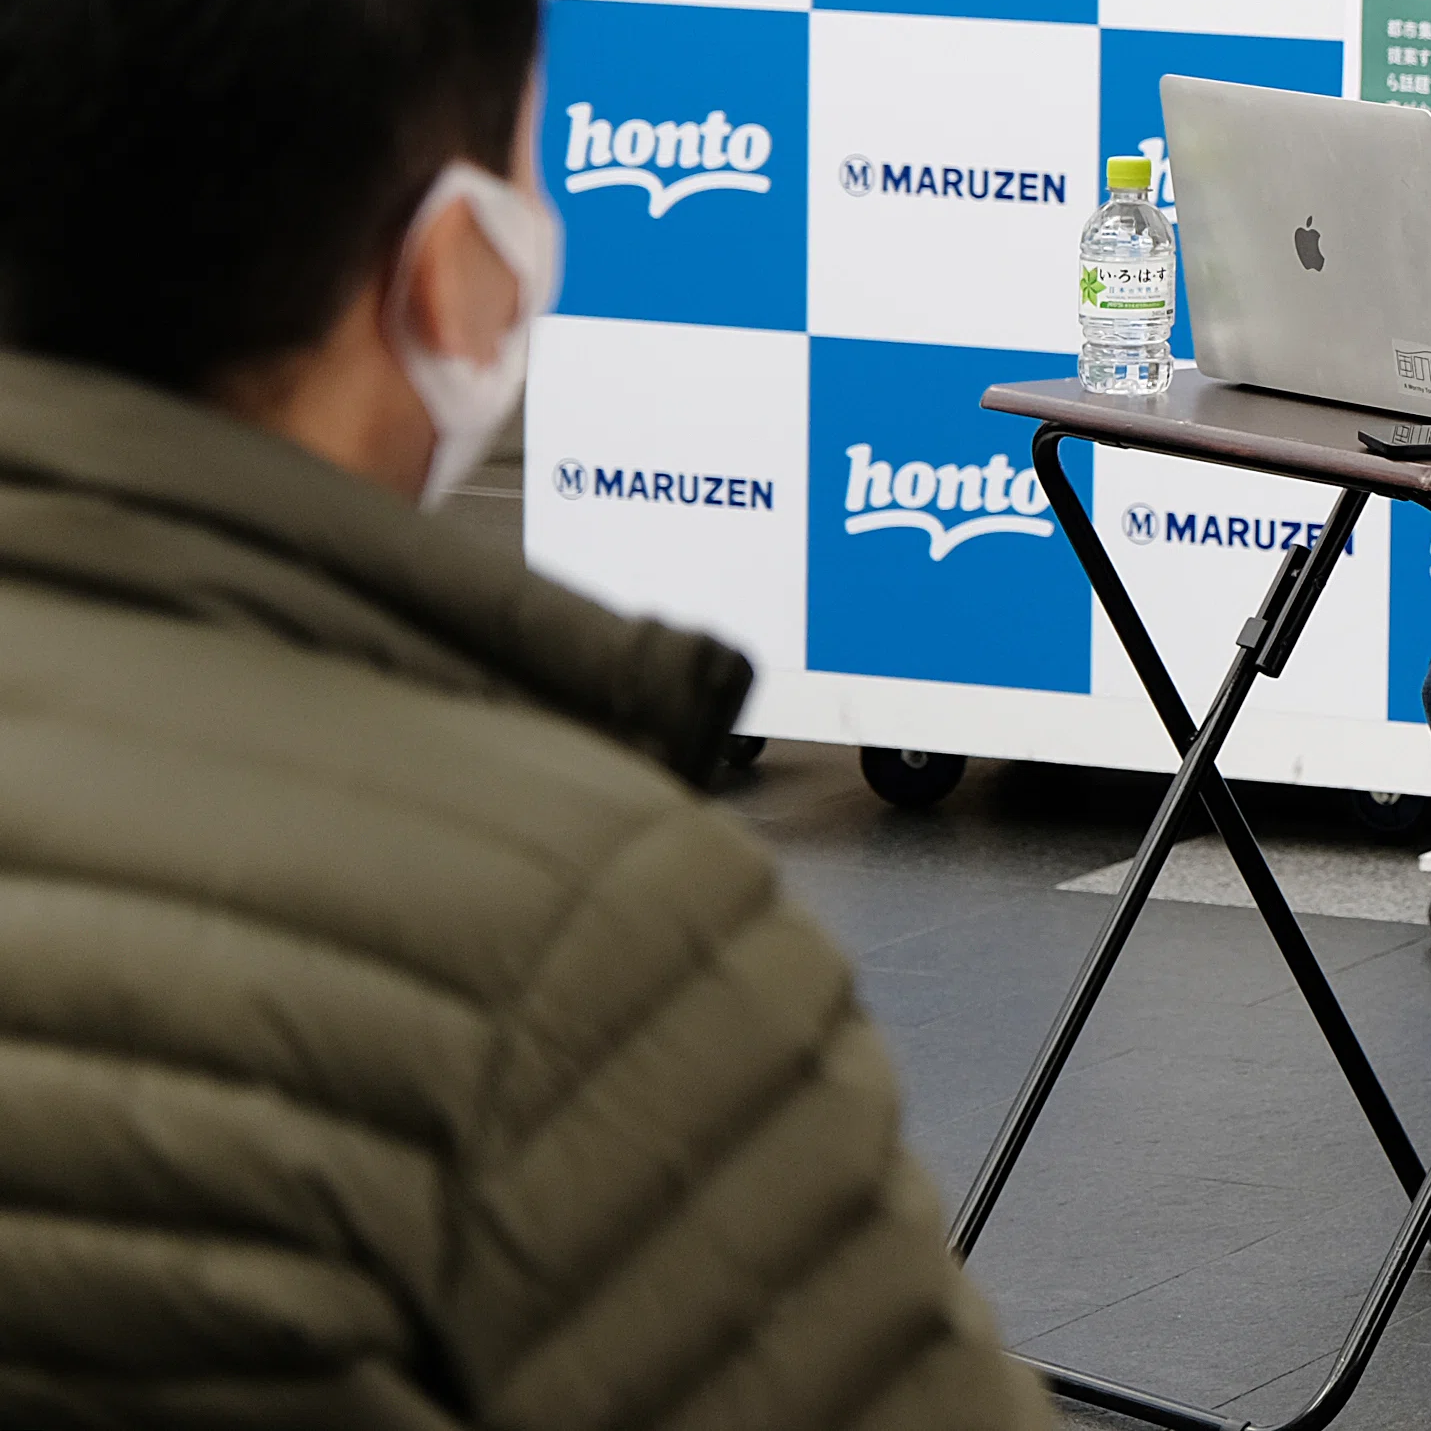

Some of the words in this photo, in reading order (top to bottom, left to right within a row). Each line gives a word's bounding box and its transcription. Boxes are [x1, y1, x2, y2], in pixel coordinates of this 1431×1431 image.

[565, 101, 772, 172] honto
[882, 164, 1067, 205] MARUZEN
[595, 468, 774, 510] MARUZEN
[845, 443, 1048, 512] honto
[1165, 512, 1355, 556] MARUZE
